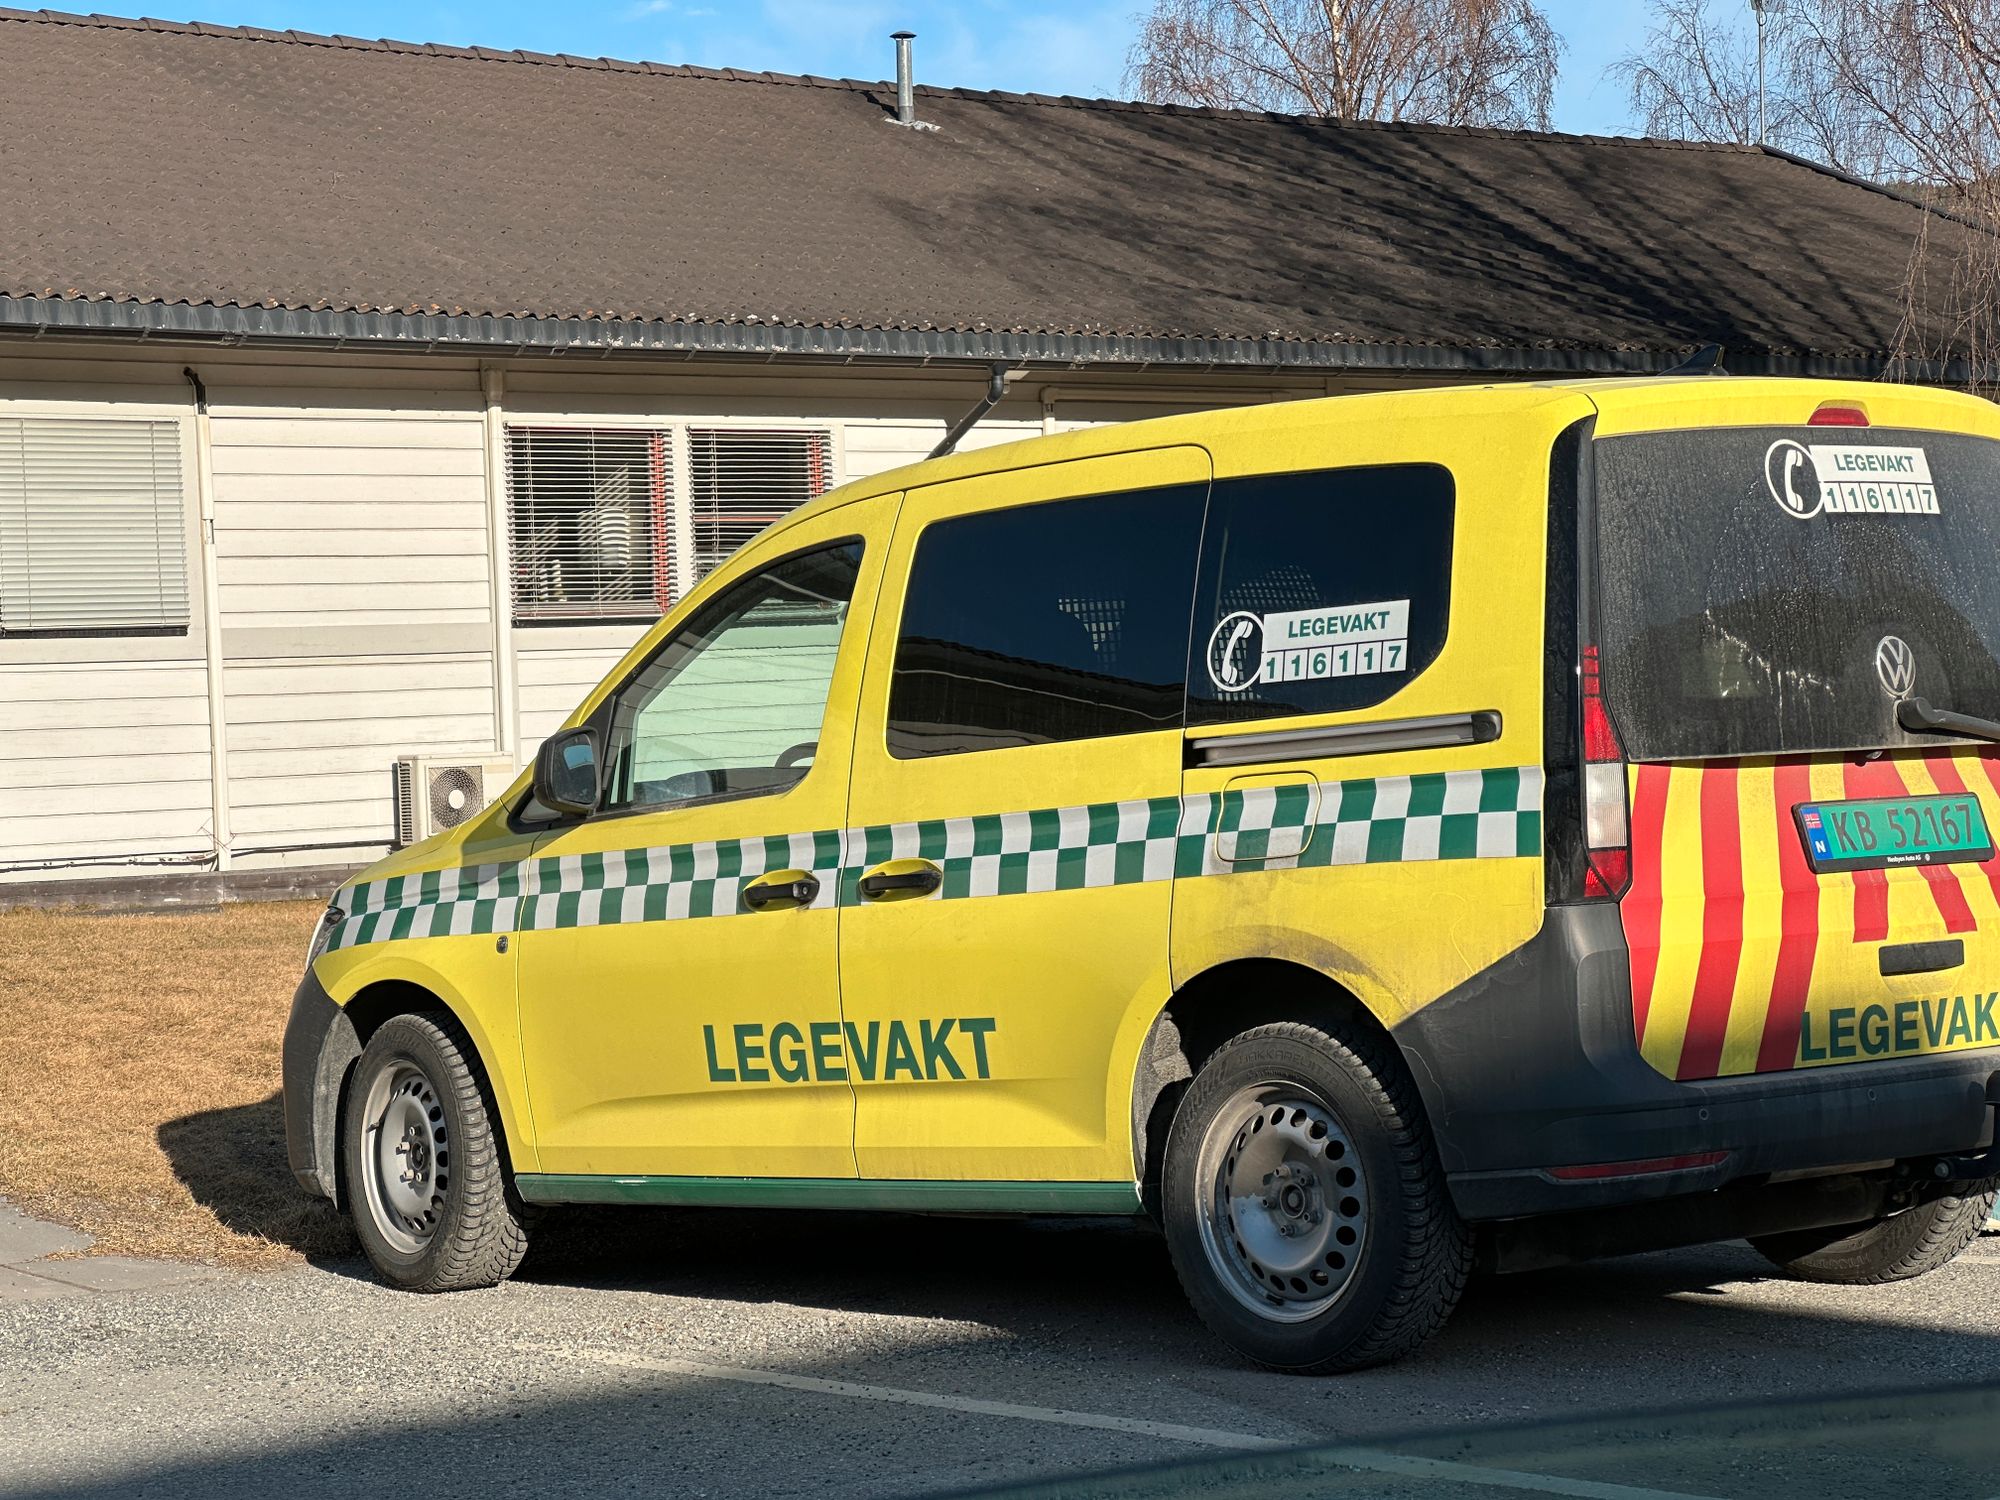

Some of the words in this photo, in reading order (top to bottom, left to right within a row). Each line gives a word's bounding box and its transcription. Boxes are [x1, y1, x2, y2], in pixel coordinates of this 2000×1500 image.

[1833, 453, 1914, 473] LEGEVAKT
[1288, 610, 1390, 638] LEGEVAKT
[1831, 811, 1877, 852] KB
[1887, 804, 1972, 849] 52167
[1815, 840, 1826, 853] N
[703, 1017, 996, 1083] LEGEVAKT
